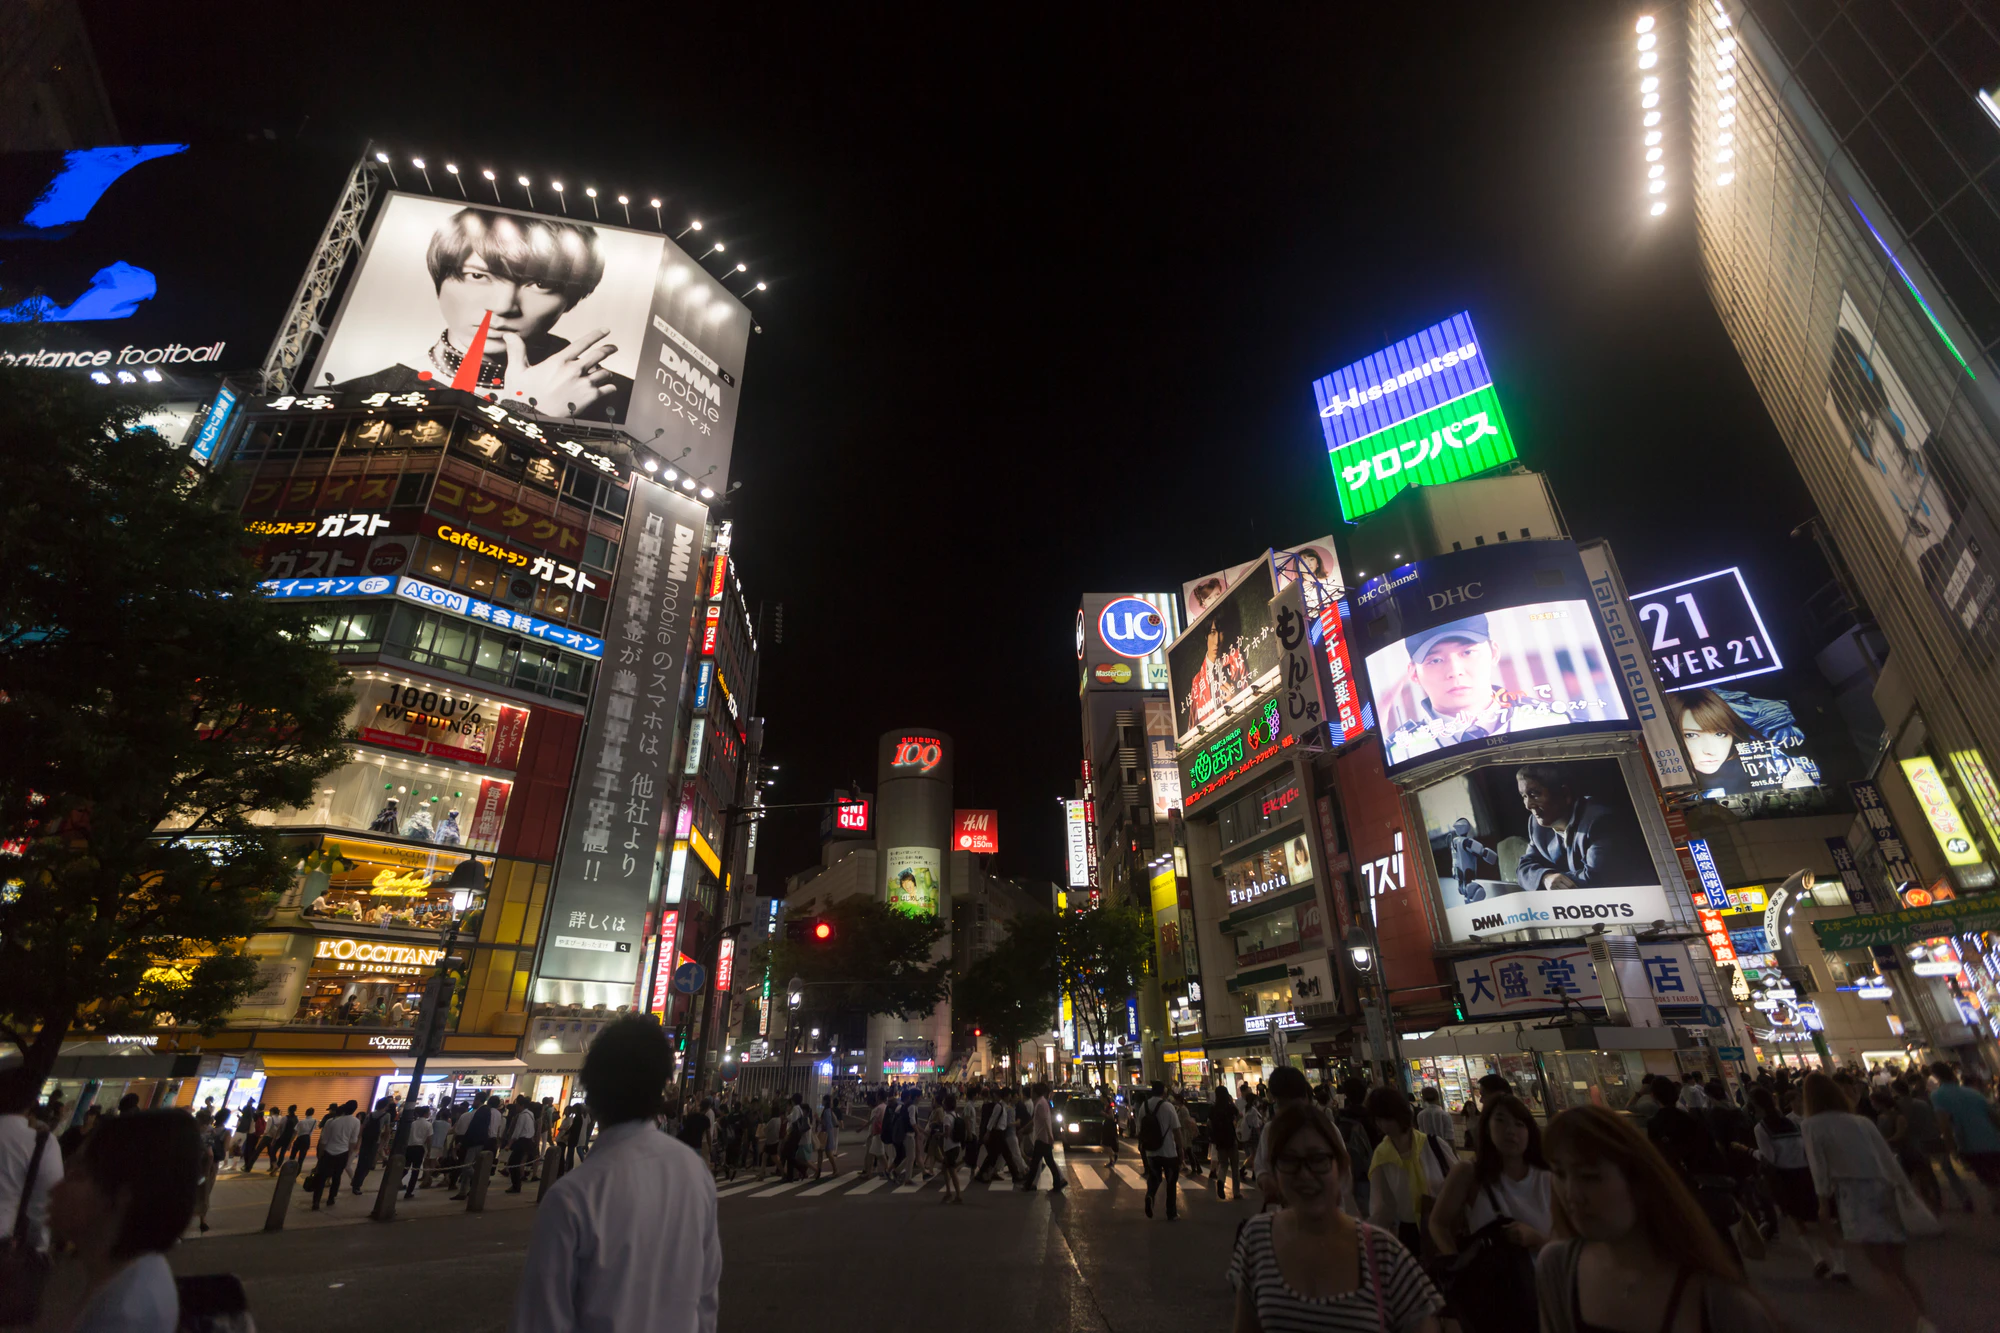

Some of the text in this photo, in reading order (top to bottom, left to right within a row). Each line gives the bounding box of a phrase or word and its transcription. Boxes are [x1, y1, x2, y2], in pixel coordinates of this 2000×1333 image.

[116, 341, 226, 366] football
[659, 343, 721, 408] DMM
[1319, 341, 1478, 419] Hisamitsu
[655, 367, 721, 425] mobile
[657, 391, 712, 438] のスマホ
[1341, 411, 1498, 491] サロンパス
[250, 479, 389, 504] プライス
[317, 513, 391, 538] ガスト
[434, 479, 580, 549] コンタクト
[268, 549, 356, 578] ガスト
[667, 523, 694, 582] DMM
[364, 580, 385, 592] 6F
[529, 556, 597, 593] ガスト
[1357, 570, 1418, 607] DHC Channel
[403, 581, 463, 611] AEON
[1427, 581, 1485, 612] DHC
[470, 601, 600, 652] 英会話イーオン
[657, 581, 682, 646] mobile
[1638, 592, 1710, 652] 21
[1591, 570, 1658, 722] Taisei neon
[1726, 635, 1766, 665] 21
[1095, 669, 1132, 678] MasterCard
[1151, 668, 1168, 678] VIS
[1275, 605, 1320, 723] もんじゃ
[1320, 608, 1357, 733] 三千里薬品
[389, 683, 482, 724] 1000%
[1569, 698, 1608, 711] スタート
[382, 702, 481, 737] WEDDING!
[508, 713, 523, 748] アウトレット
[493, 725, 510, 765] ドレスセール
[901, 736, 941, 746] SHIBUYA
[1211, 736, 1244, 776] 西村
[1486, 735, 1509, 747] DHC
[1655, 747, 1676, 759] (03)
[1735, 735, 1805, 756] 藍井エイル
[890, 743, 943, 773] 109
[1657, 756, 1681, 768] 3719
[1659, 764, 1684, 776] 2468
[684, 781, 697, 789] 5F
[1159, 782, 1180, 792] まで
[478, 785, 502, 836] 毎日開催
[840, 801, 864, 815] UNI
[840, 814, 865, 827] QLO
[963, 814, 989, 831] H&M
[973, 840, 993, 848] 150m
[1854, 784, 1919, 883] 洋服の青山
[1947, 838, 1969, 853] 4F
[1070, 821, 1085, 885] Essential
[1229, 873, 1288, 905] Euphoria
[1692, 842, 1725, 907] 大盛堂商事ビル
[568, 911, 626, 932] 詳しくは
[1302, 905, 1321, 931] JTB
[1472, 902, 1634, 932] DMM.make ROBOTS
[316, 939, 446, 965] L'OCCITANE
[338, 962, 421, 975] EN PROVENCE
[1466, 955, 1686, 1005] 大盛堂店
[1671, 994, 1700, 1003] TAISEIDO
[368, 1035, 413, 1046] L'OCCITA
